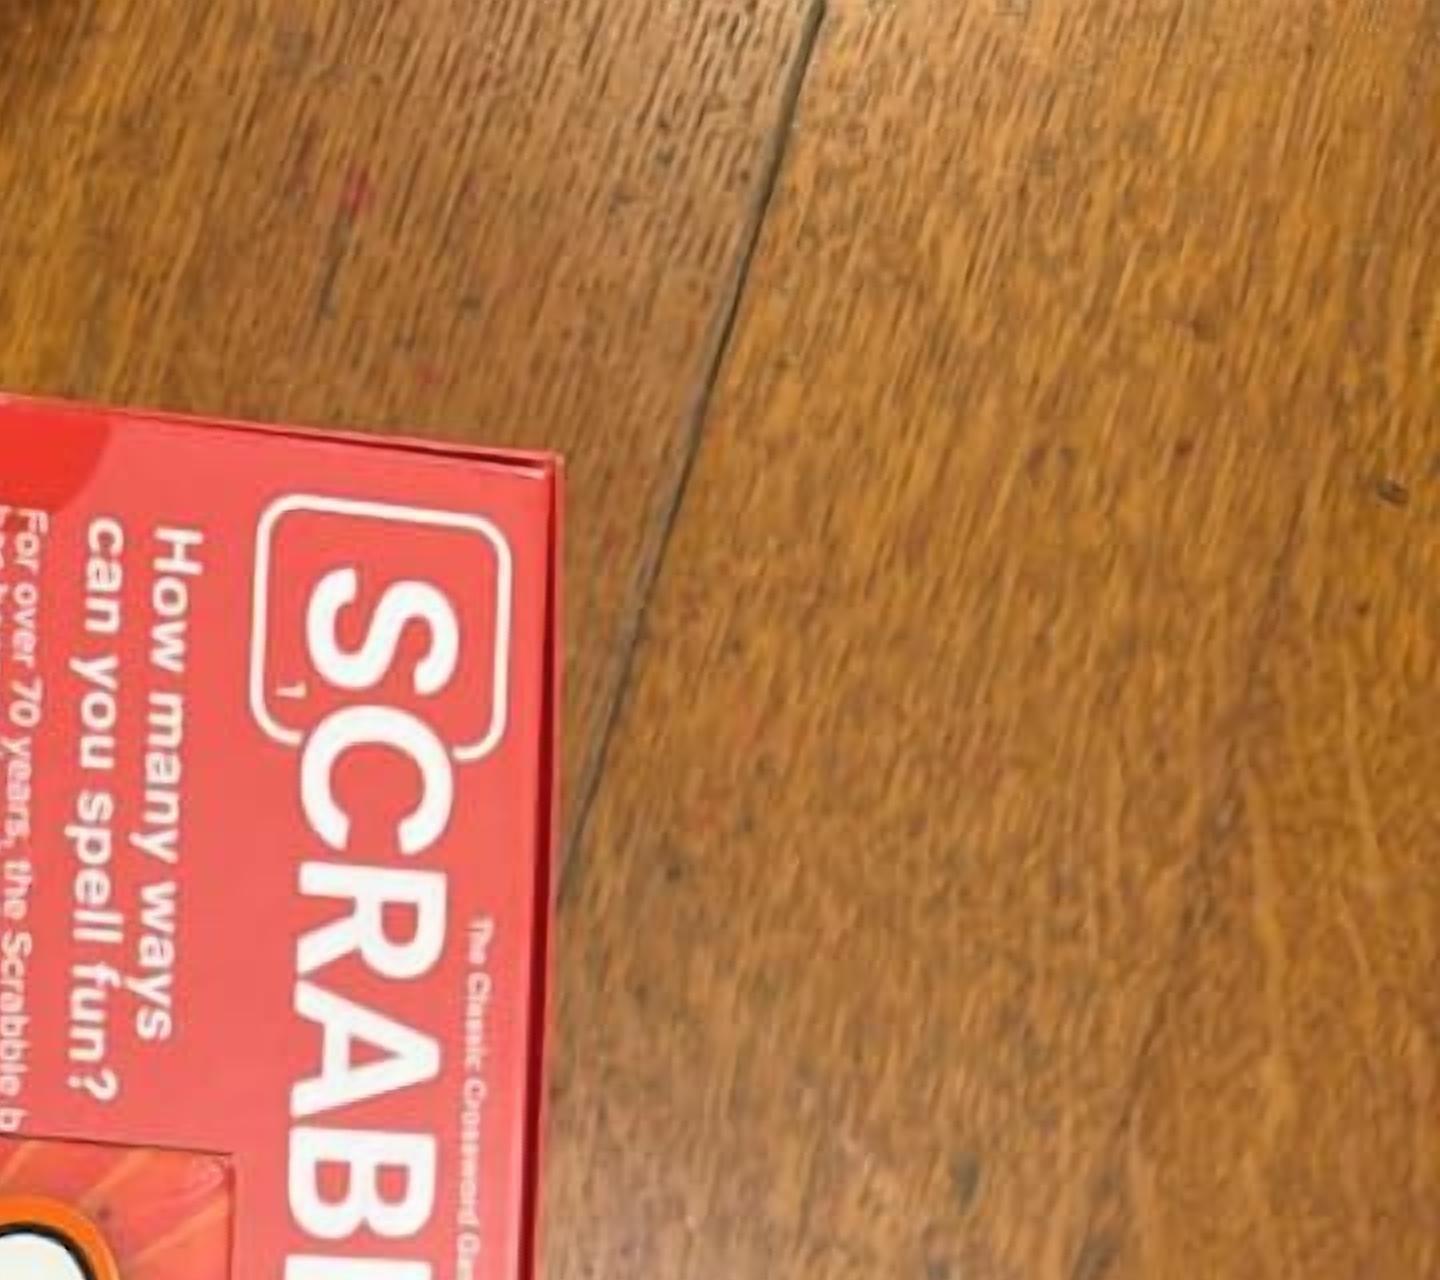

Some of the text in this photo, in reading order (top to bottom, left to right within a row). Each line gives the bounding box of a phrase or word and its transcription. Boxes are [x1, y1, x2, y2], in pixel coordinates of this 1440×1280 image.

[14, 510, 48, 572] For
[13, 582, 40, 666] over
[9, 679, 42, 727] 70
[1, 737, 34, 848] years,
[65, 517, 124, 1100] can you spell fun?
[122, 526, 201, 1040] How many ways
[3, 859, 32, 920] the
[468, 916, 494, 965] The
[464, 972, 492, 1067] Classic
[458, 1079, 487, 1226] Crossword
